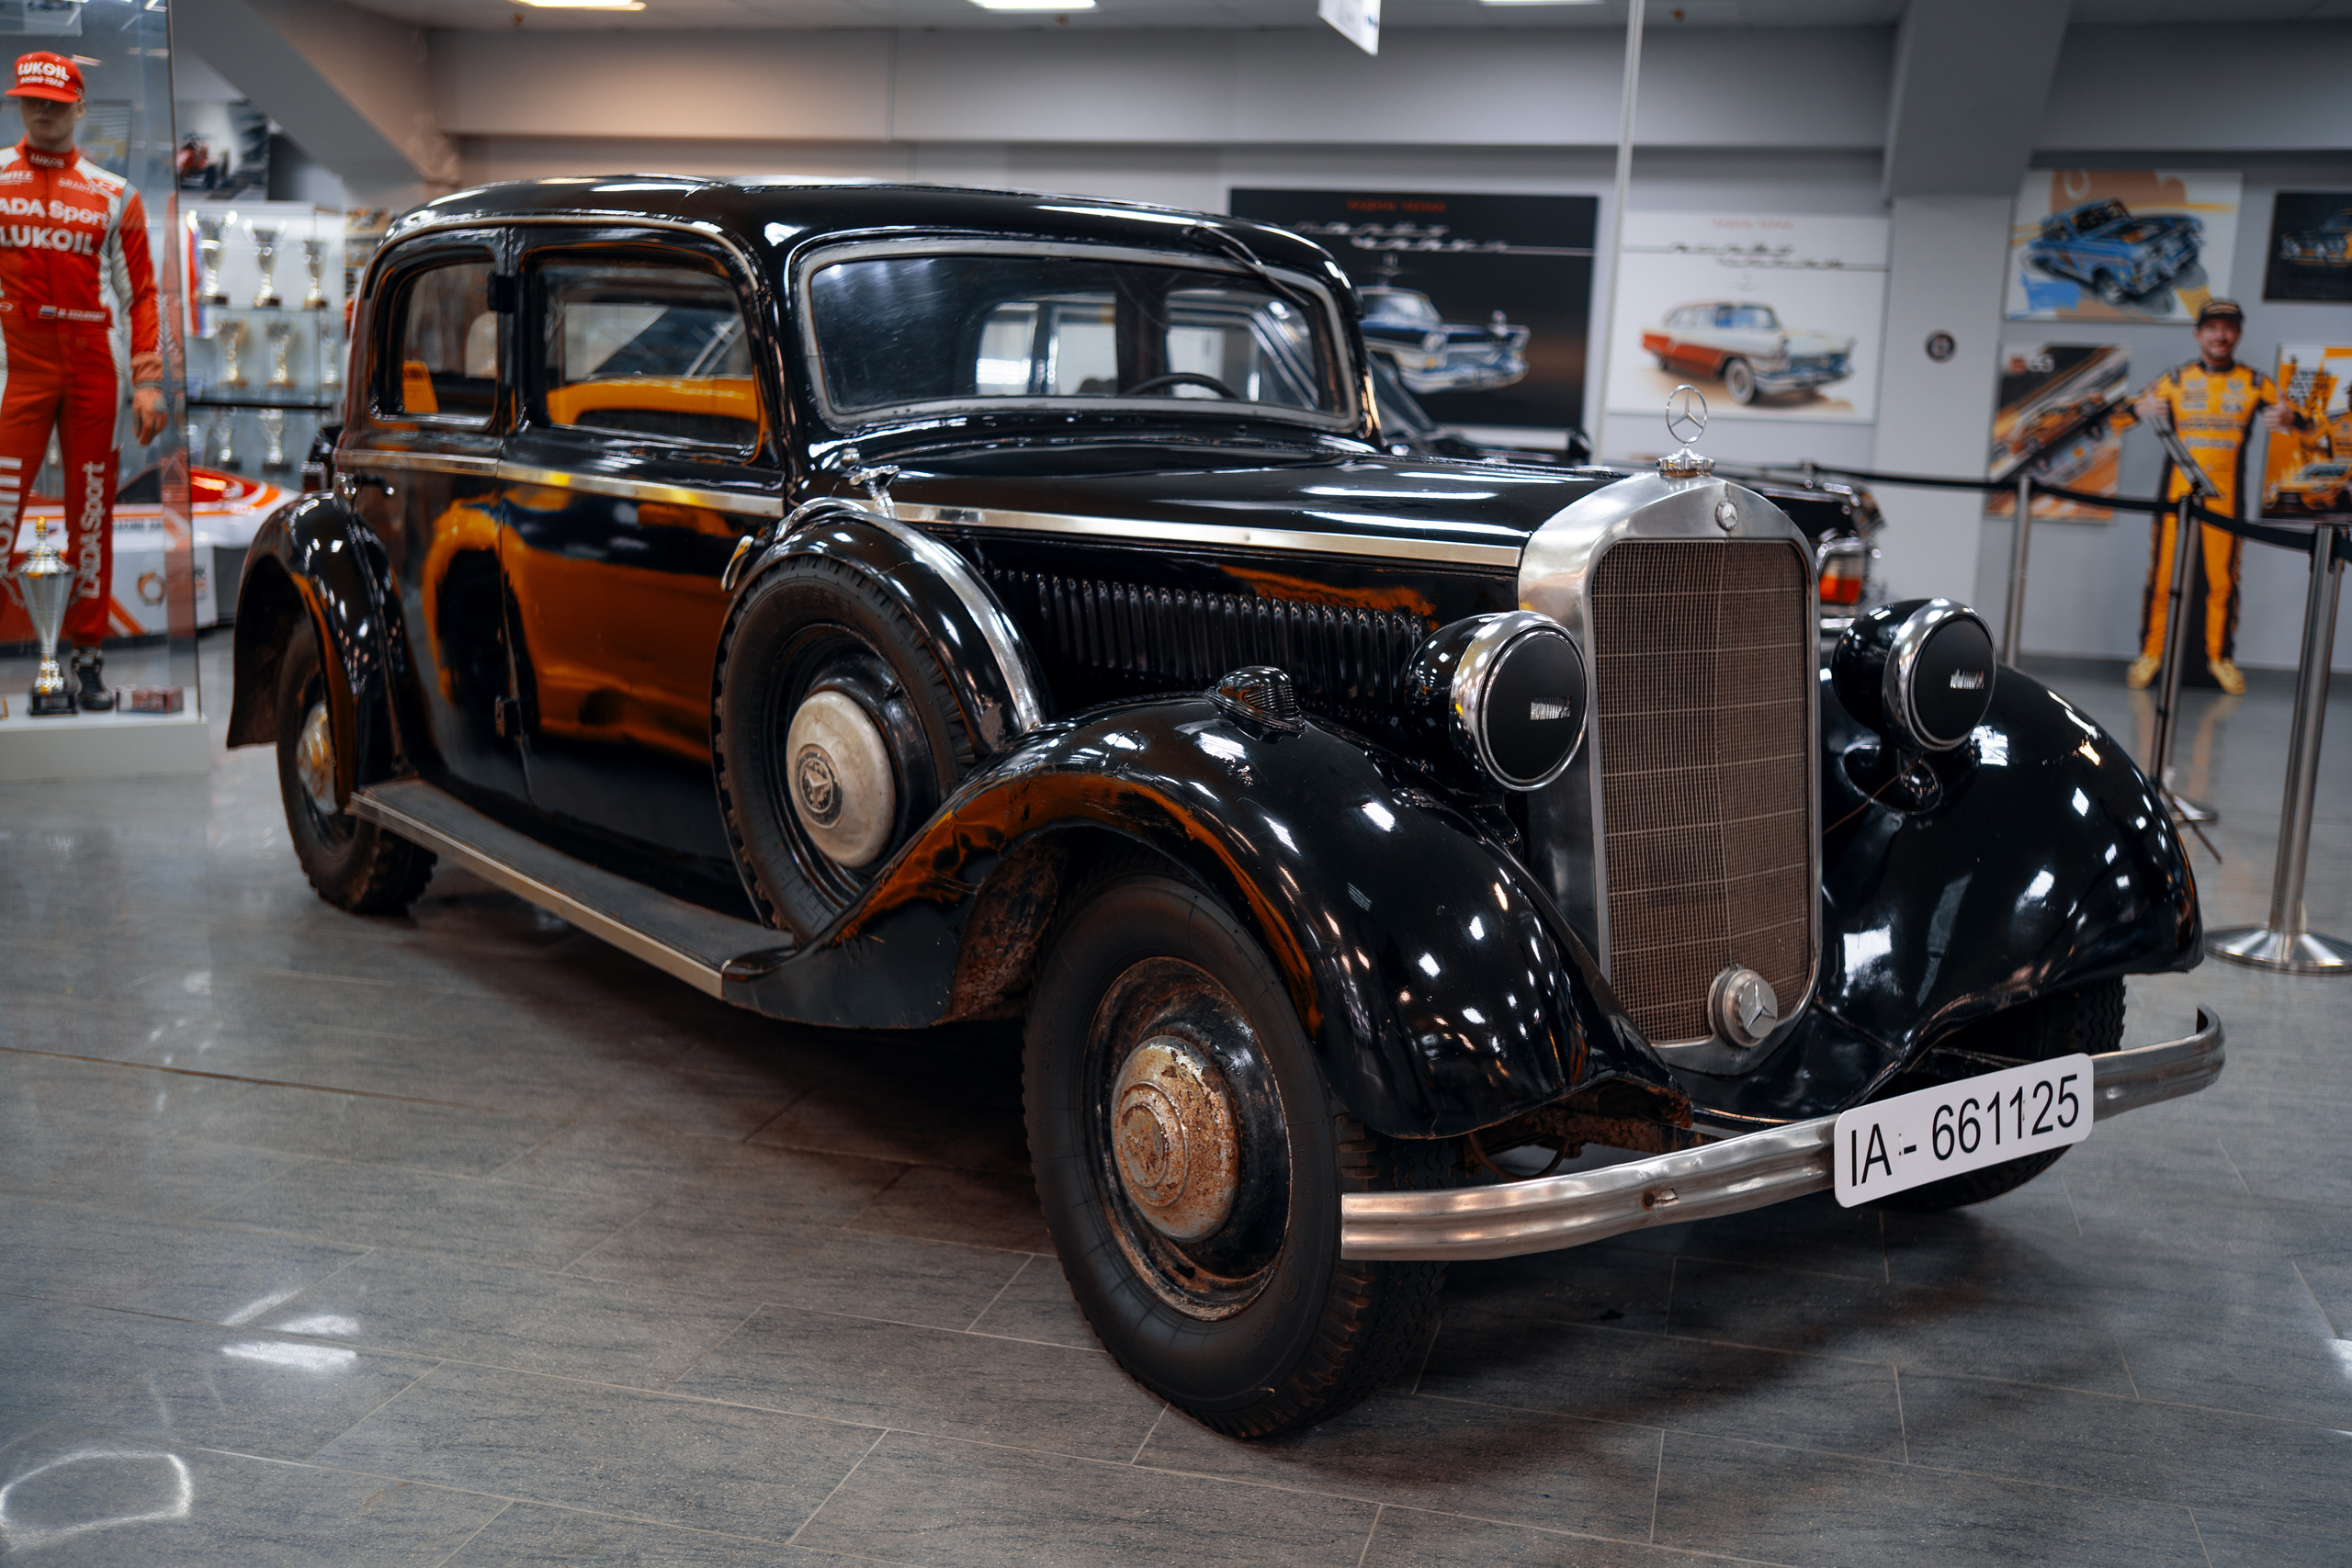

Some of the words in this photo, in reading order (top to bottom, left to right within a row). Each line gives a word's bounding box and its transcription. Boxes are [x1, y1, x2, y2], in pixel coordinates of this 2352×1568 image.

[17, 61, 71, 82] LUKOIL
[29, 152, 66, 169] LUKOIL
[0, 197, 47, 219] ADA
[48, 199, 109, 231] Sport
[0, 225, 94, 256] LUKOIL
[1931, 1073, 2080, 1161] 661125
